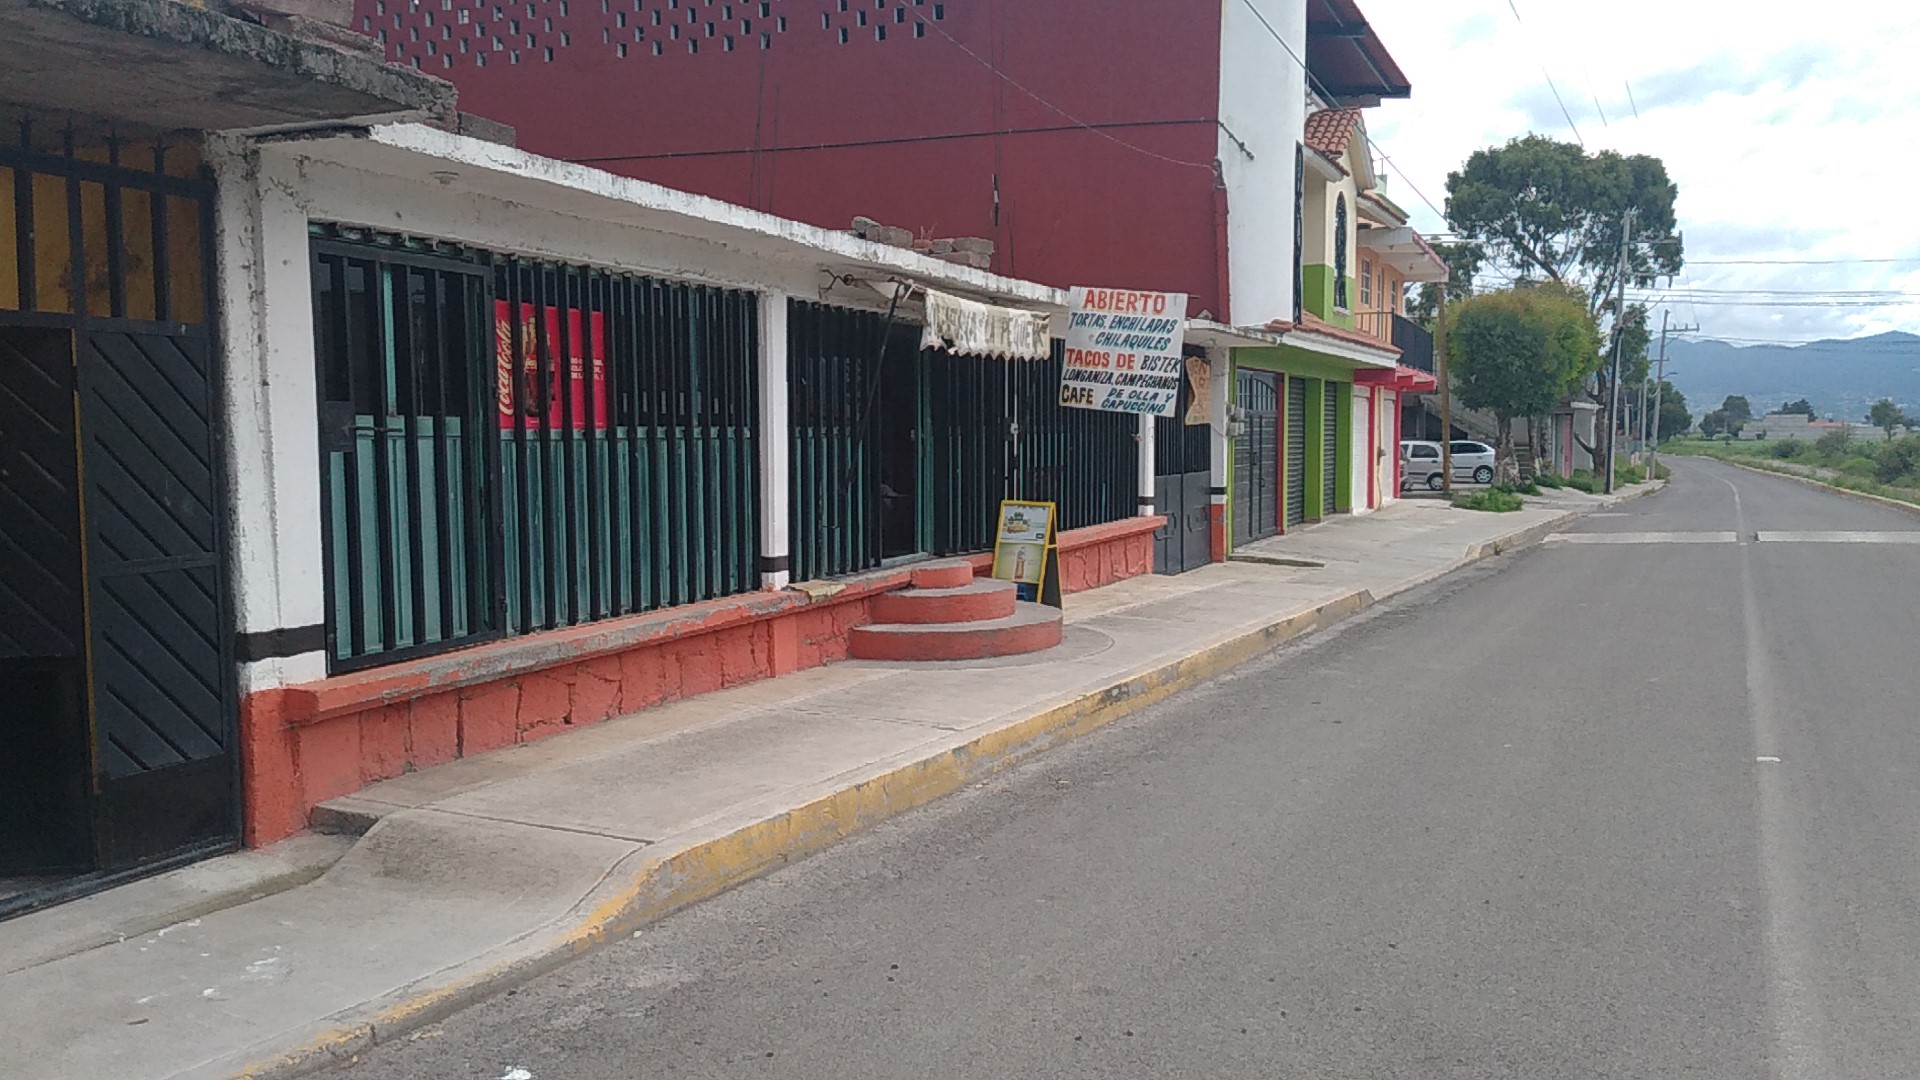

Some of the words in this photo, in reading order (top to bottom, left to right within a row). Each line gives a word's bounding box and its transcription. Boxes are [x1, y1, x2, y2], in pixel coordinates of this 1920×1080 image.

[1083, 289, 1166, 315] ABIERTO
[1109, 315, 1178, 334] ENCHILADAS
[1094, 332, 1171, 351] CHILAQUILES
[1066, 349, 1110, 368] TACOS
[1116, 354, 1135, 369] DE
[1140, 355, 1181, 373] BISTEK
[1114, 373, 1179, 390] CAMPECHANOS
[1062, 384, 1094, 405] CAFE
[1108, 388, 1122, 398] DE
[1128, 390, 1159, 401] OLLA
[1165, 394, 1174, 403] Y
[1101, 399, 1167, 413] CAPUCCINO
